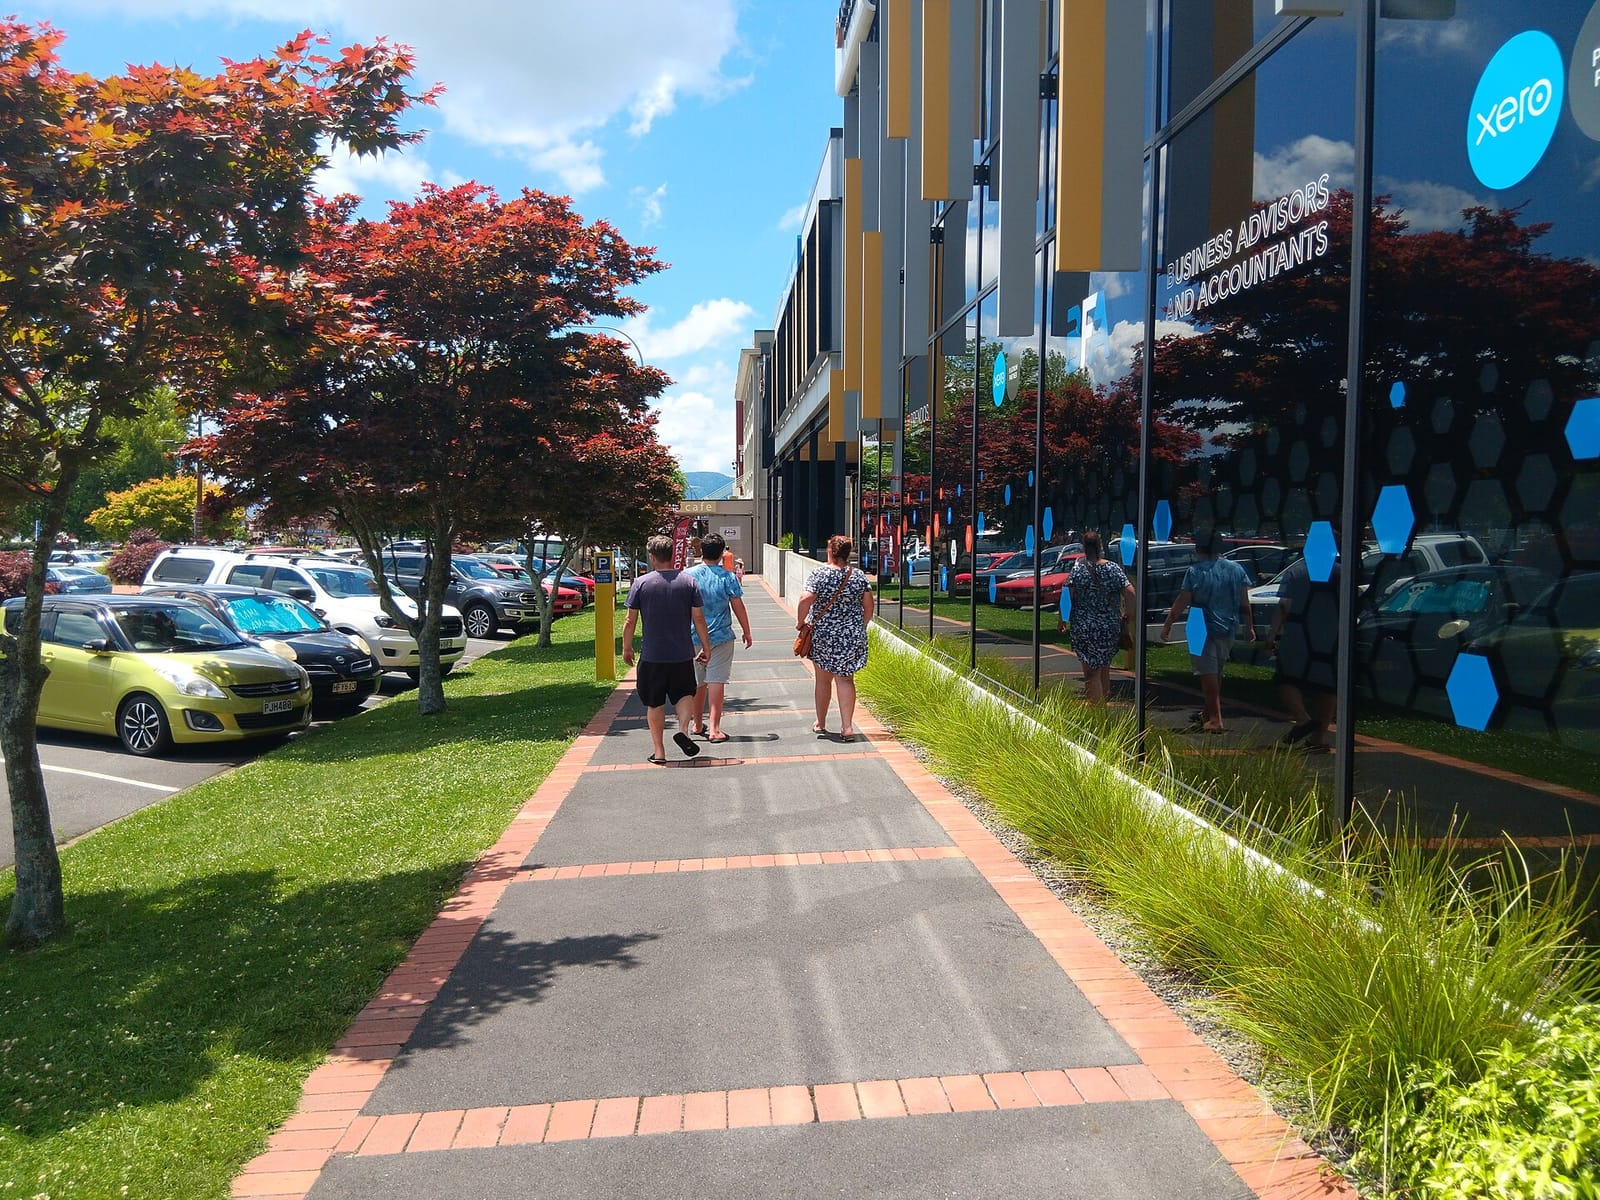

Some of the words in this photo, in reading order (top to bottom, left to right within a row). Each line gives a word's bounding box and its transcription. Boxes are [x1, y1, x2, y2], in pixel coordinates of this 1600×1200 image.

[1475, 78, 1552, 146] xero
[1166, 228, 1233, 289] BUSINESS
[1236, 173, 1329, 253] ADVISORS
[1166, 288, 1194, 321] AND
[1197, 220, 1329, 310] ACCOUNTANTS
[685, 501, 712, 512] cafe
[598, 557, 608, 569] P
[673, 538, 684, 570] OPEN
